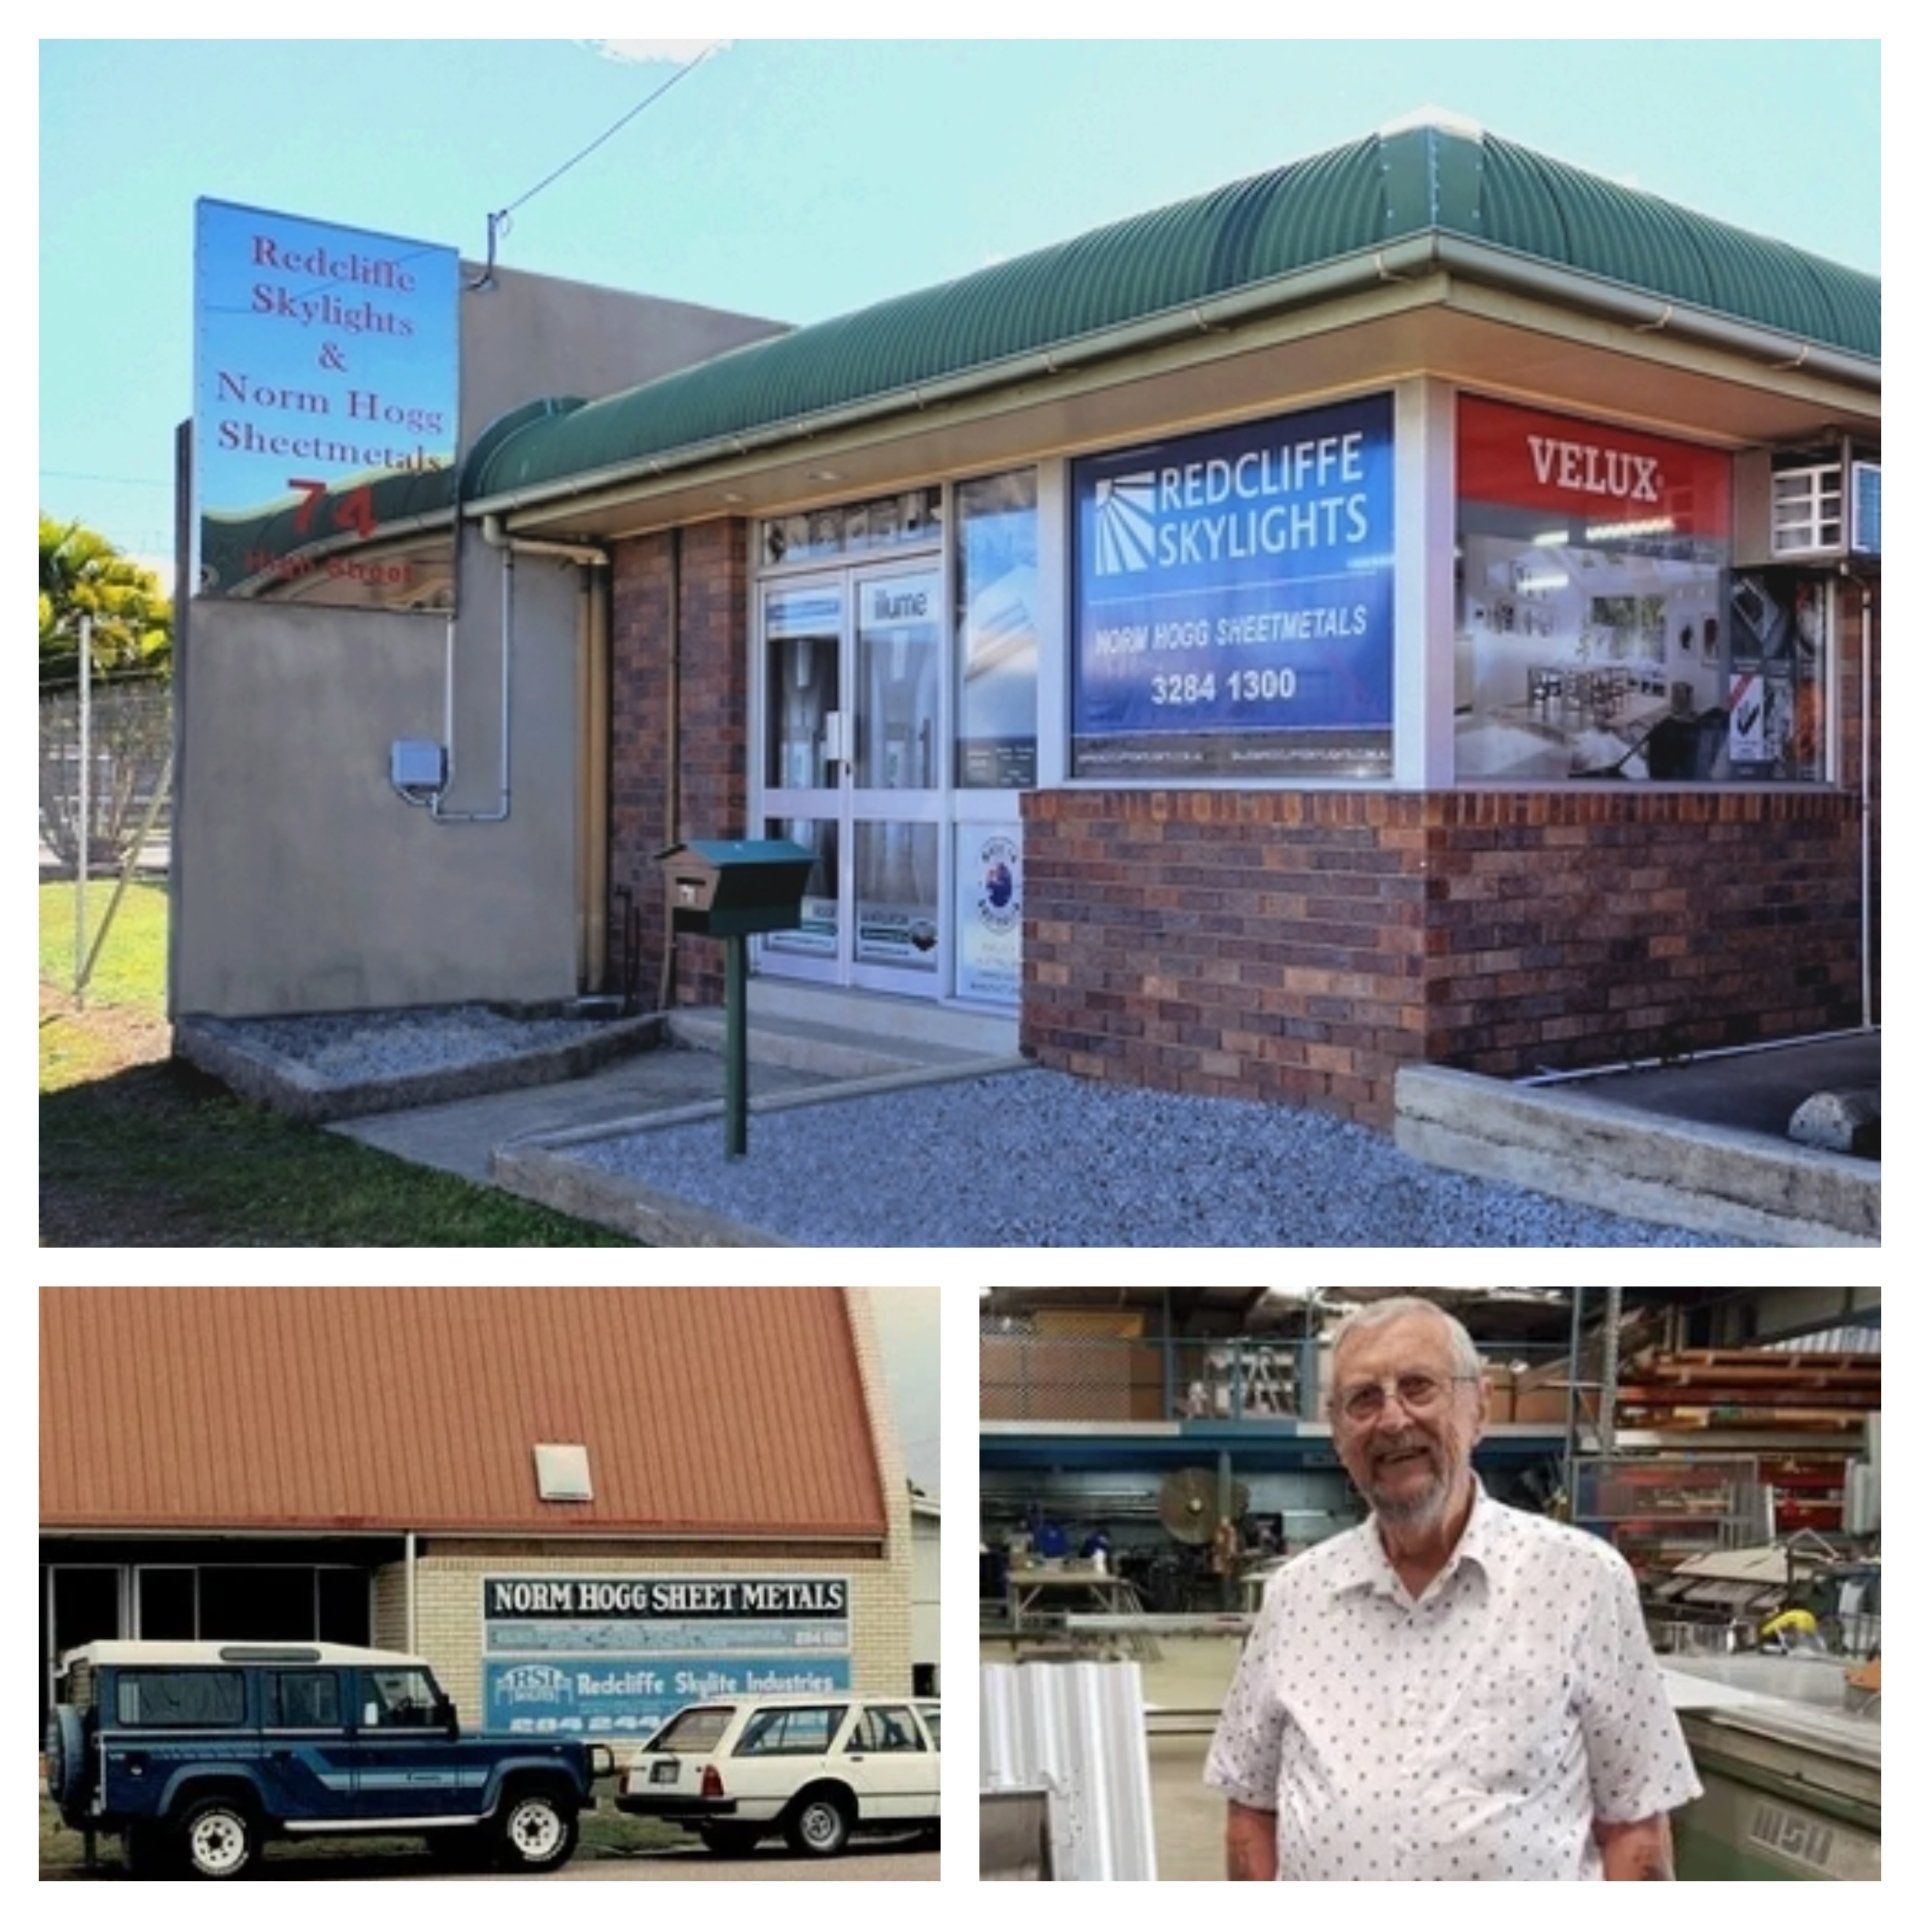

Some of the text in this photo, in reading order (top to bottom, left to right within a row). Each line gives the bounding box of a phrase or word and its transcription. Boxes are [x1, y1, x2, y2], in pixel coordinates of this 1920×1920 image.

[251, 234, 416, 293] Redcliffe
[251, 283, 414, 338] Skylights
[317, 341, 348, 372] &
[216, 371, 444, 435] Norm Hogg
[218, 419, 443, 473] Sheetmetals
[1161, 431, 1364, 512] REDCLIFFE
[1526, 434, 1658, 502] VELUX
[287, 478, 379, 540] 74
[1159, 493, 1369, 568] SKYLIGHTS
[327, 557, 415, 584] Street
[874, 589, 929, 620] illume
[1095, 604, 1368, 655] NORM HOGG SHEETMETALS
[1151, 667, 1296, 704] 3284 1300
[494, 1582, 844, 1611] NORM HOGG SHEET METALS
[577, 1671, 664, 1695] Redcliffe
[674, 1671, 738, 1698] Skylite
[745, 1671, 834, 1694] Industries
